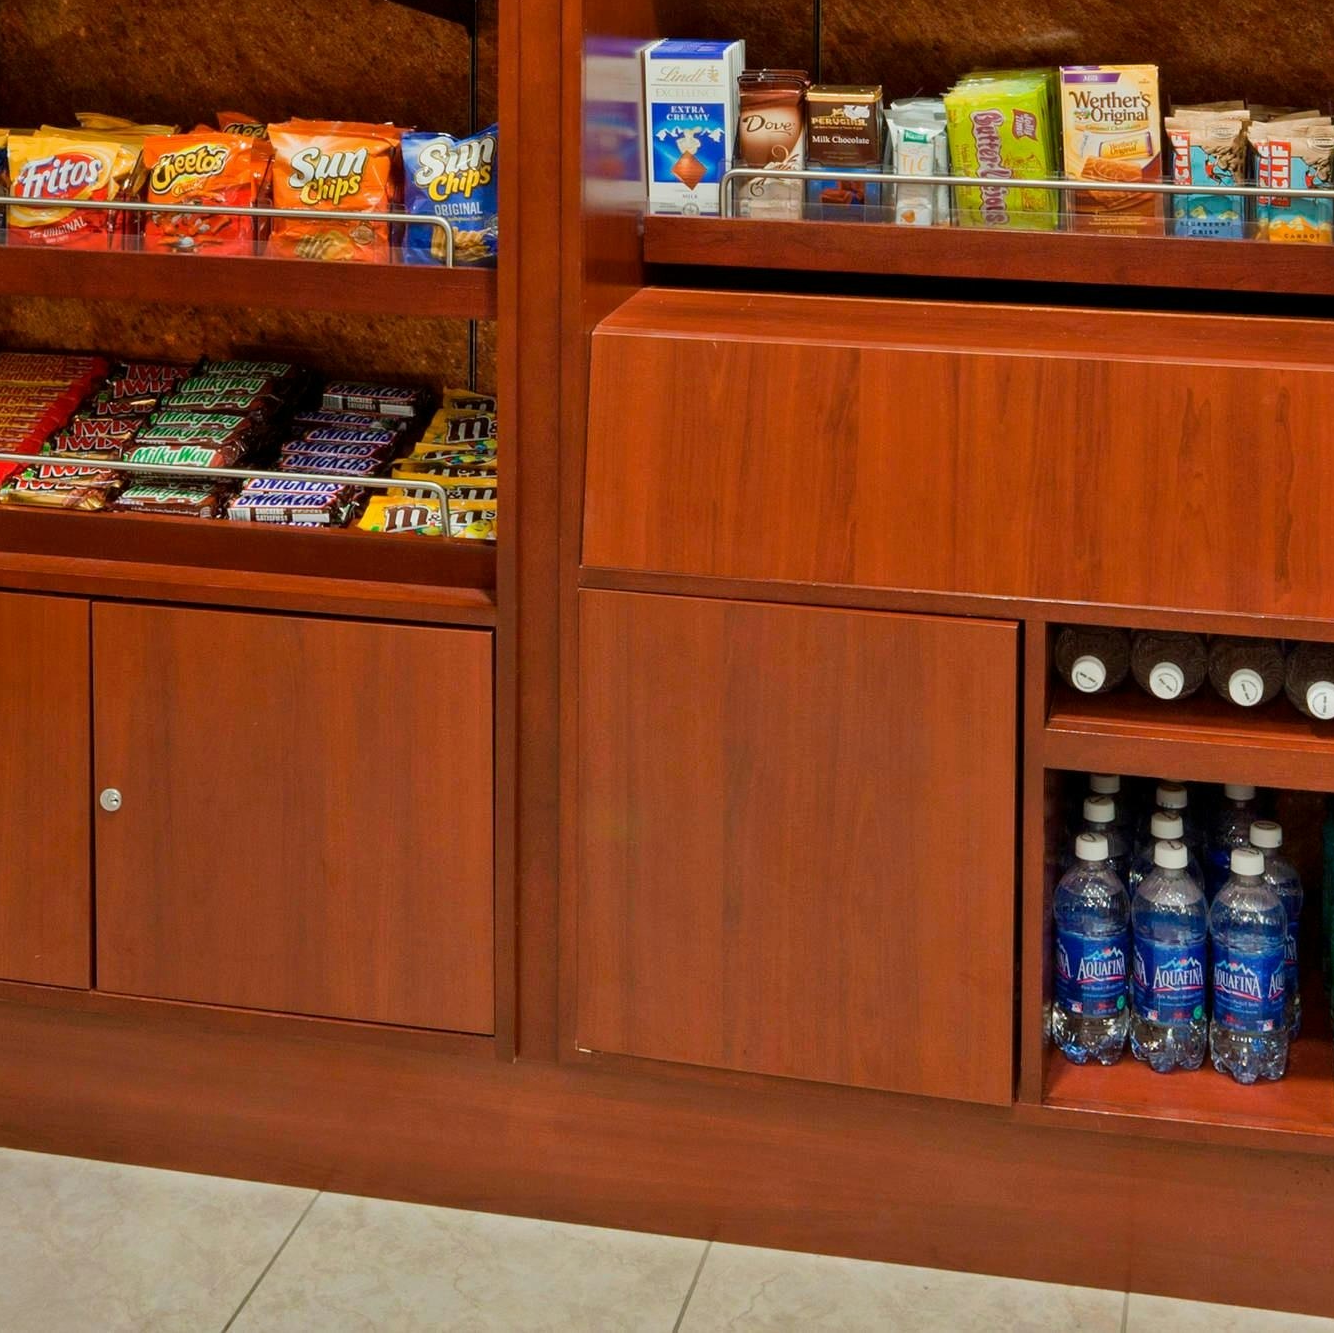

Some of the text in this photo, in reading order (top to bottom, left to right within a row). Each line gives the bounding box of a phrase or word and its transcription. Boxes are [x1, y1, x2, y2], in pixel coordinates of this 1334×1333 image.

[657, 66, 708, 84] Lindt
[1069, 90, 1152, 109] Werther's
[666, 113, 710, 123] CREAMY
[670, 105, 705, 114] EXTRA
[1090, 109, 1149, 125] Original
[742, 115, 794, 133] Dove
[812, 135, 870, 145] Milk Chocolate
[288, 146, 368, 188] Sun
[416, 136, 497, 188] Sun
[1172, 133, 1190, 184] CLIF
[1271, 145, 1290, 189] CLIF
[19, 156, 102, 199] Fritos
[152, 144, 229, 194] Cheetos
[299, 174, 362, 205] Chips
[428, 165, 492, 202] Chips
[434, 201, 483, 216] ORIGINAL
[43, 217, 88, 238] ORIGINAL
[74, 418, 144, 437] TWIX
[308, 429, 395, 444] SNICKERS
[56, 434, 124, 452] TWIX
[287, 441, 380, 458] SNICKERS
[287, 454, 380, 472] SNICKERS
[236, 494, 335, 508] SNICKERS
